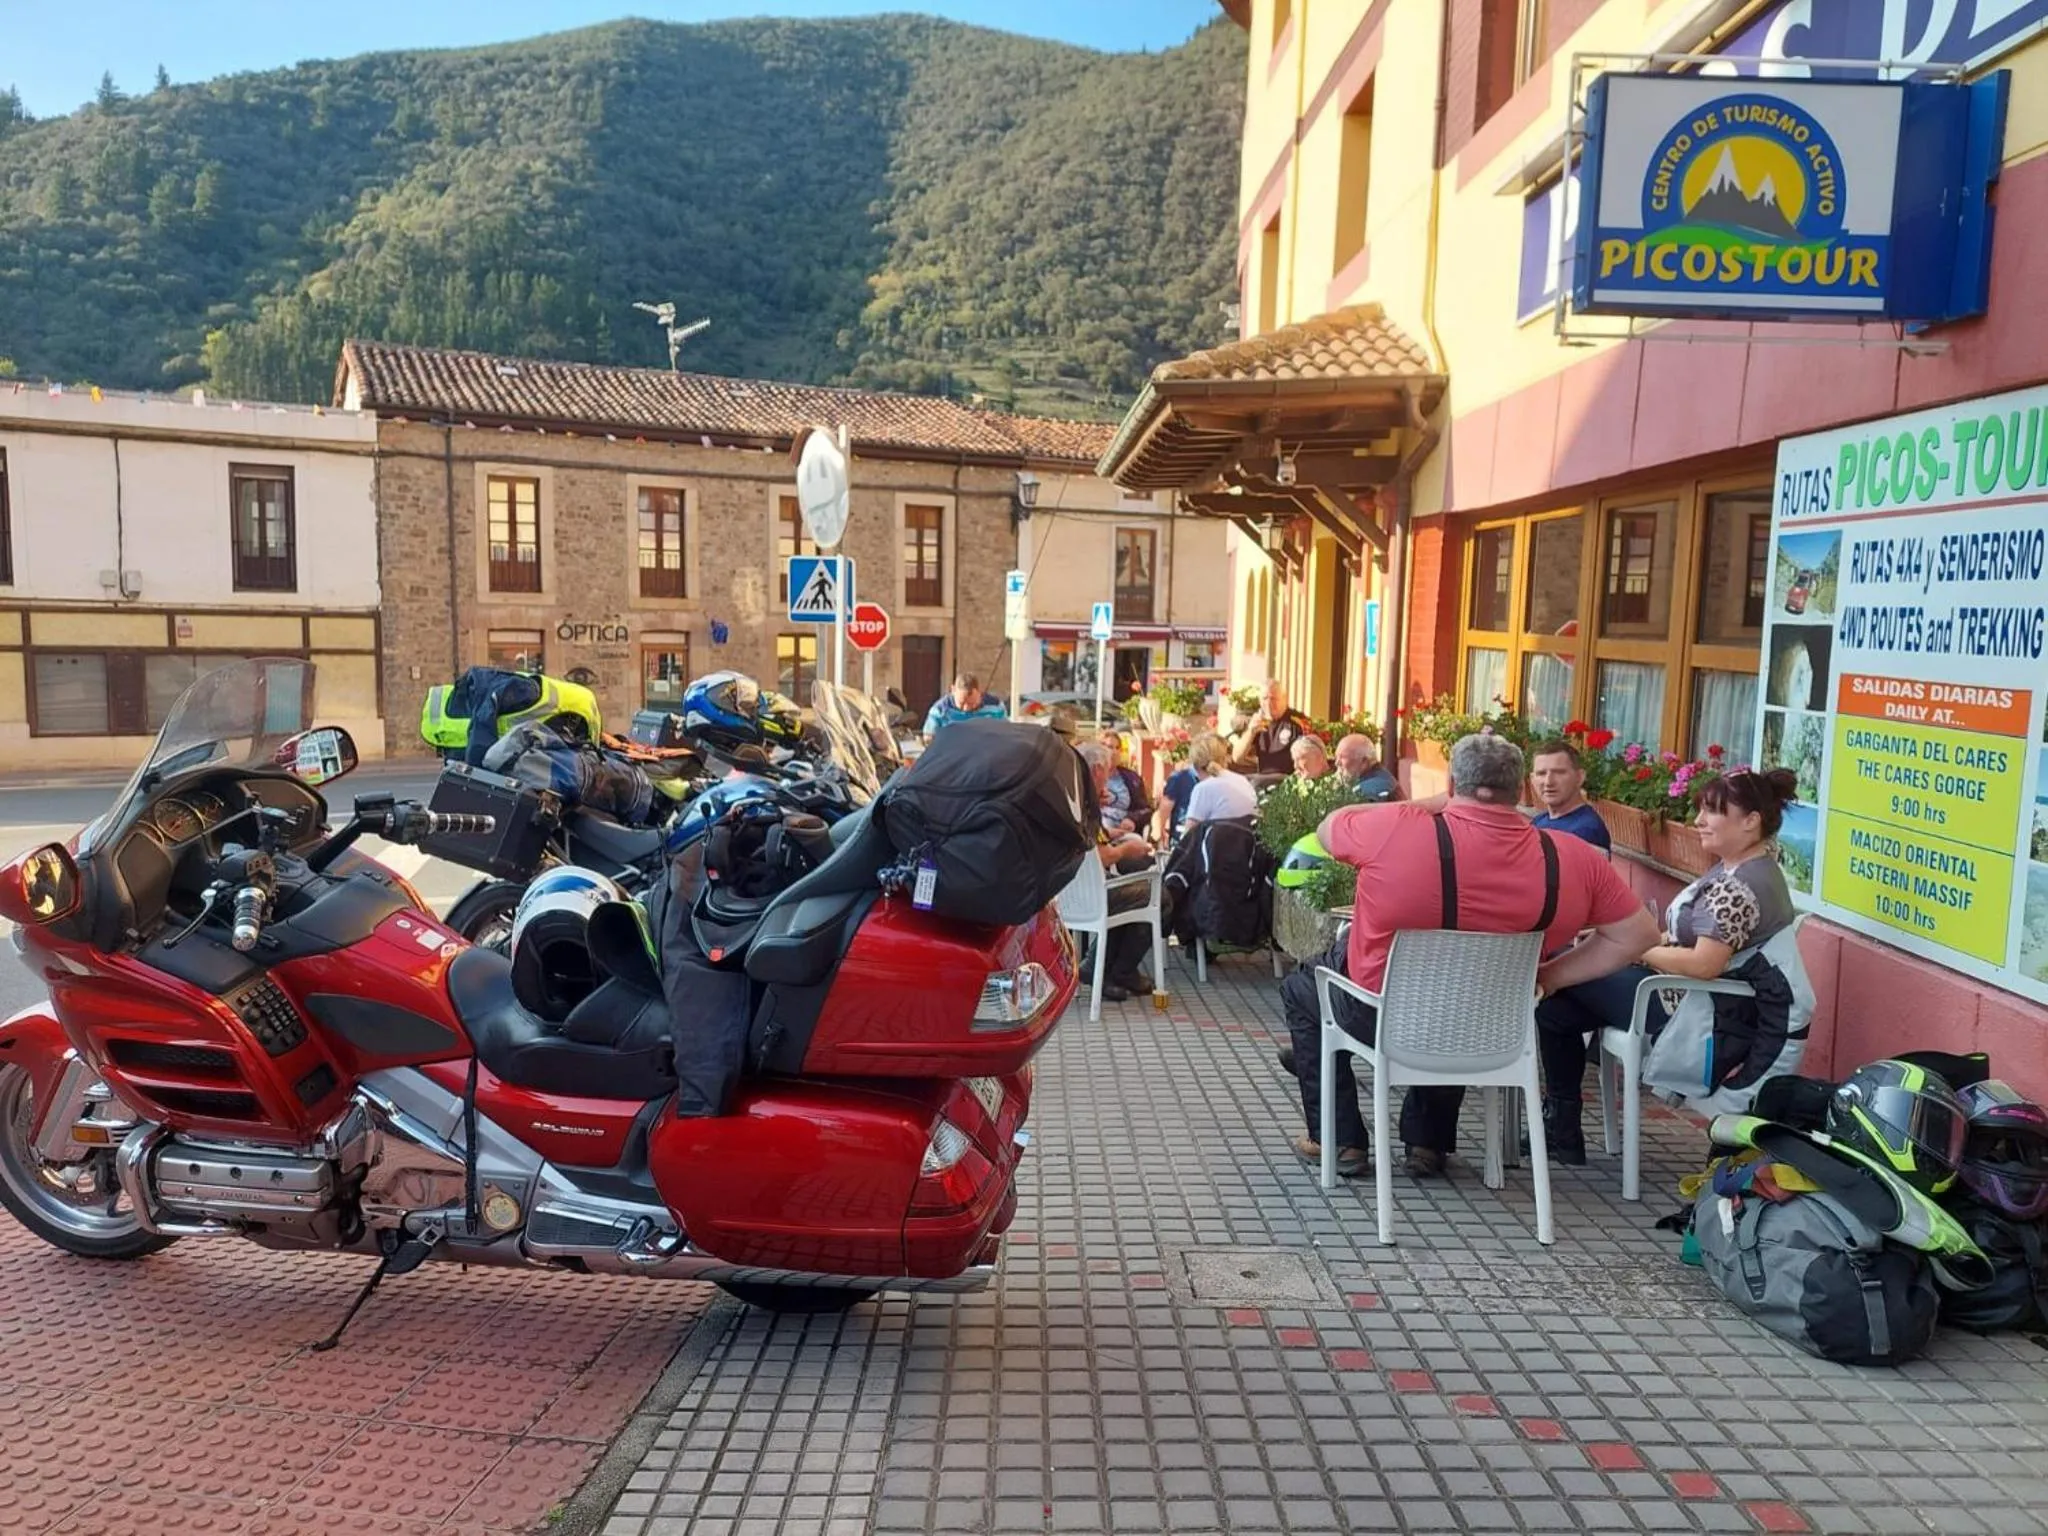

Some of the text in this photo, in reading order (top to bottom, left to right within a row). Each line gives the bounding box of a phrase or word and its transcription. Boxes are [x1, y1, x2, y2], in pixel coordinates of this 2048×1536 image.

[1651, 104, 1835, 216] CENTRO DE TURISMO ACTIVO
[1599, 238, 1879, 288] PICOSTOUR
[1780, 466, 1833, 517] RUTAS
[1850, 528, 2045, 594] RUTAS 4X4 y SENDERISMO
[850, 620, 885, 634] STOP
[1839, 605, 2045, 660] 4WD ROUTES and TREKKING
[1852, 677, 2013, 709] SALIDAS DIARIAS
[1885, 702, 1929, 722] DAILY
[1846, 729, 2008, 773] GARGANTA DEL CARES
[1856, 758, 1987, 802] THE CARES GORGE
[1891, 796, 1946, 825] 9:00 hrs
[1850, 828, 1977, 882] MACIZO ORIENTAL
[1850, 857, 1973, 912] EASTERN MASSIF
[1875, 894, 1936, 931] 10:00 hrs
